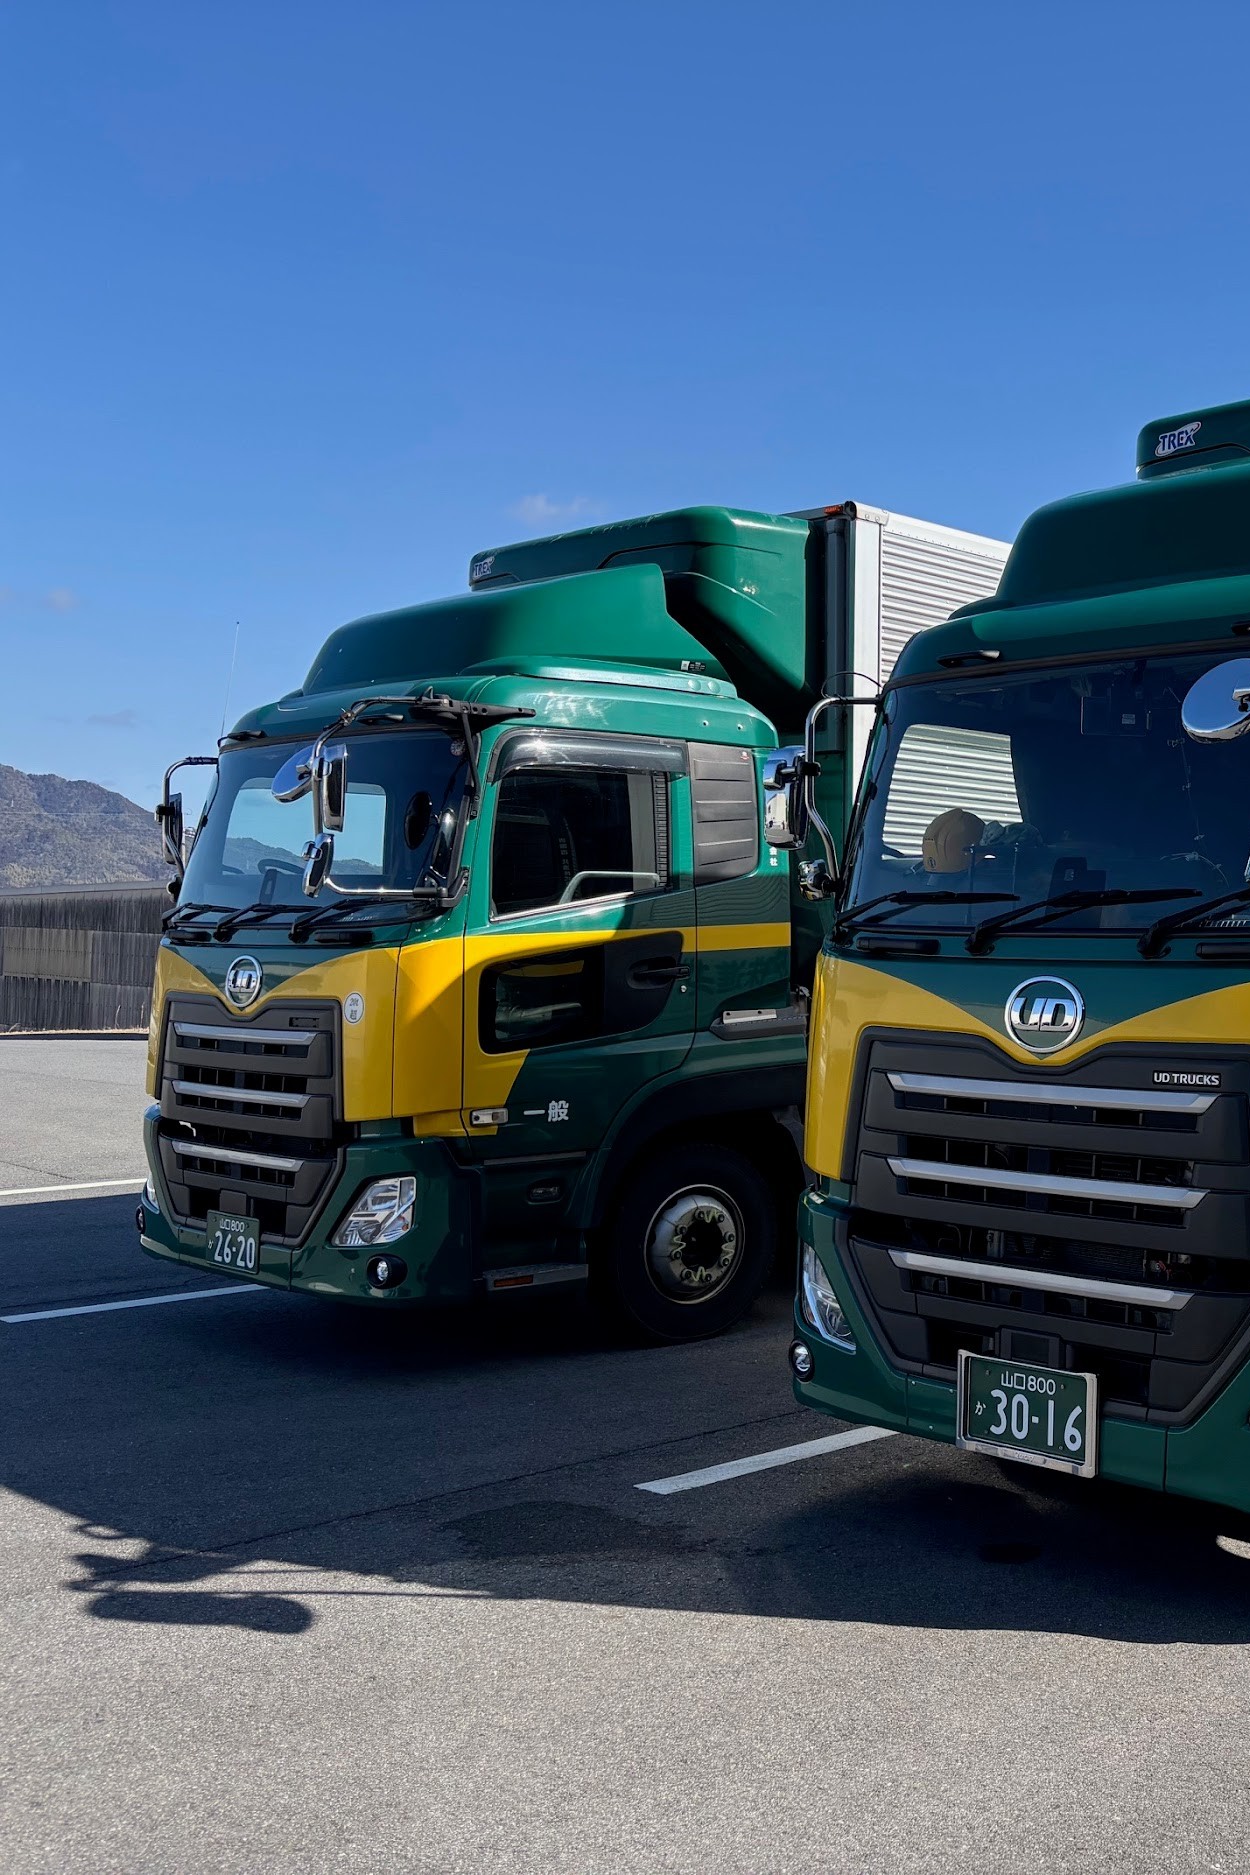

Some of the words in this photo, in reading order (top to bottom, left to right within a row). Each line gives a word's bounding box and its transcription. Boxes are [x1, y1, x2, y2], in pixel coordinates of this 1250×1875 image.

[1160, 427, 1195, 451] TREX
[1011, 997, 1077, 1032] UD
[1154, 1072, 1170, 1083] UD
[1172, 1074, 1220, 1086] TRUCKS
[523, 1100, 569, 1122] 一般
[214, 1230, 256, 1269] 26-20
[974, 1401, 987, 1416] か
[990, 1389, 1083, 1452] 30-16
